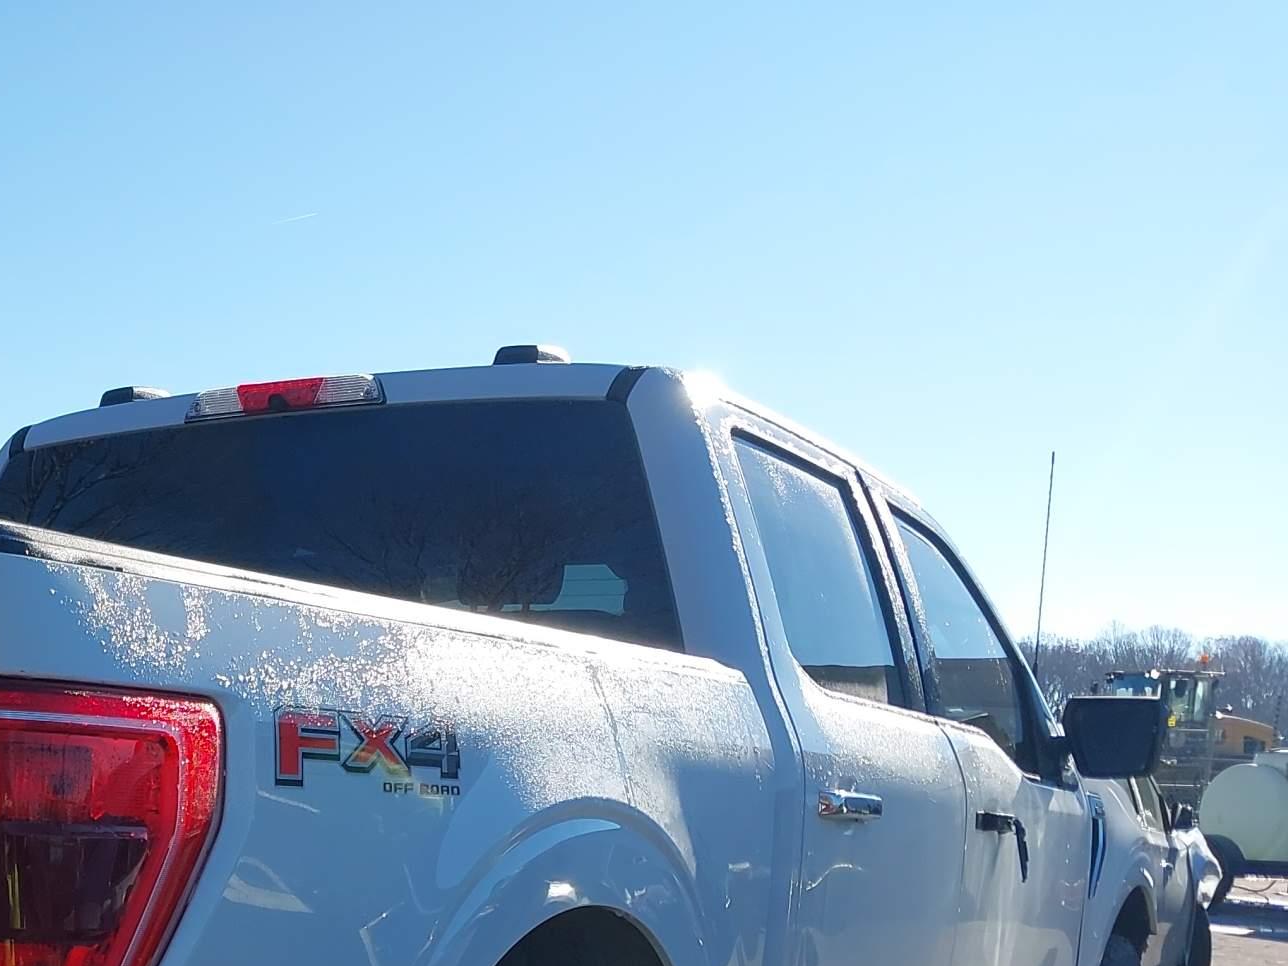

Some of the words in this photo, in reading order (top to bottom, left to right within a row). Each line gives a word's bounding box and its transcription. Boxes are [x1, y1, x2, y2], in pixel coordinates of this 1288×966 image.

[274, 705, 461, 787] FX4
[383, 782, 414, 794] OFF
[419, 783, 460, 796] ROAD
